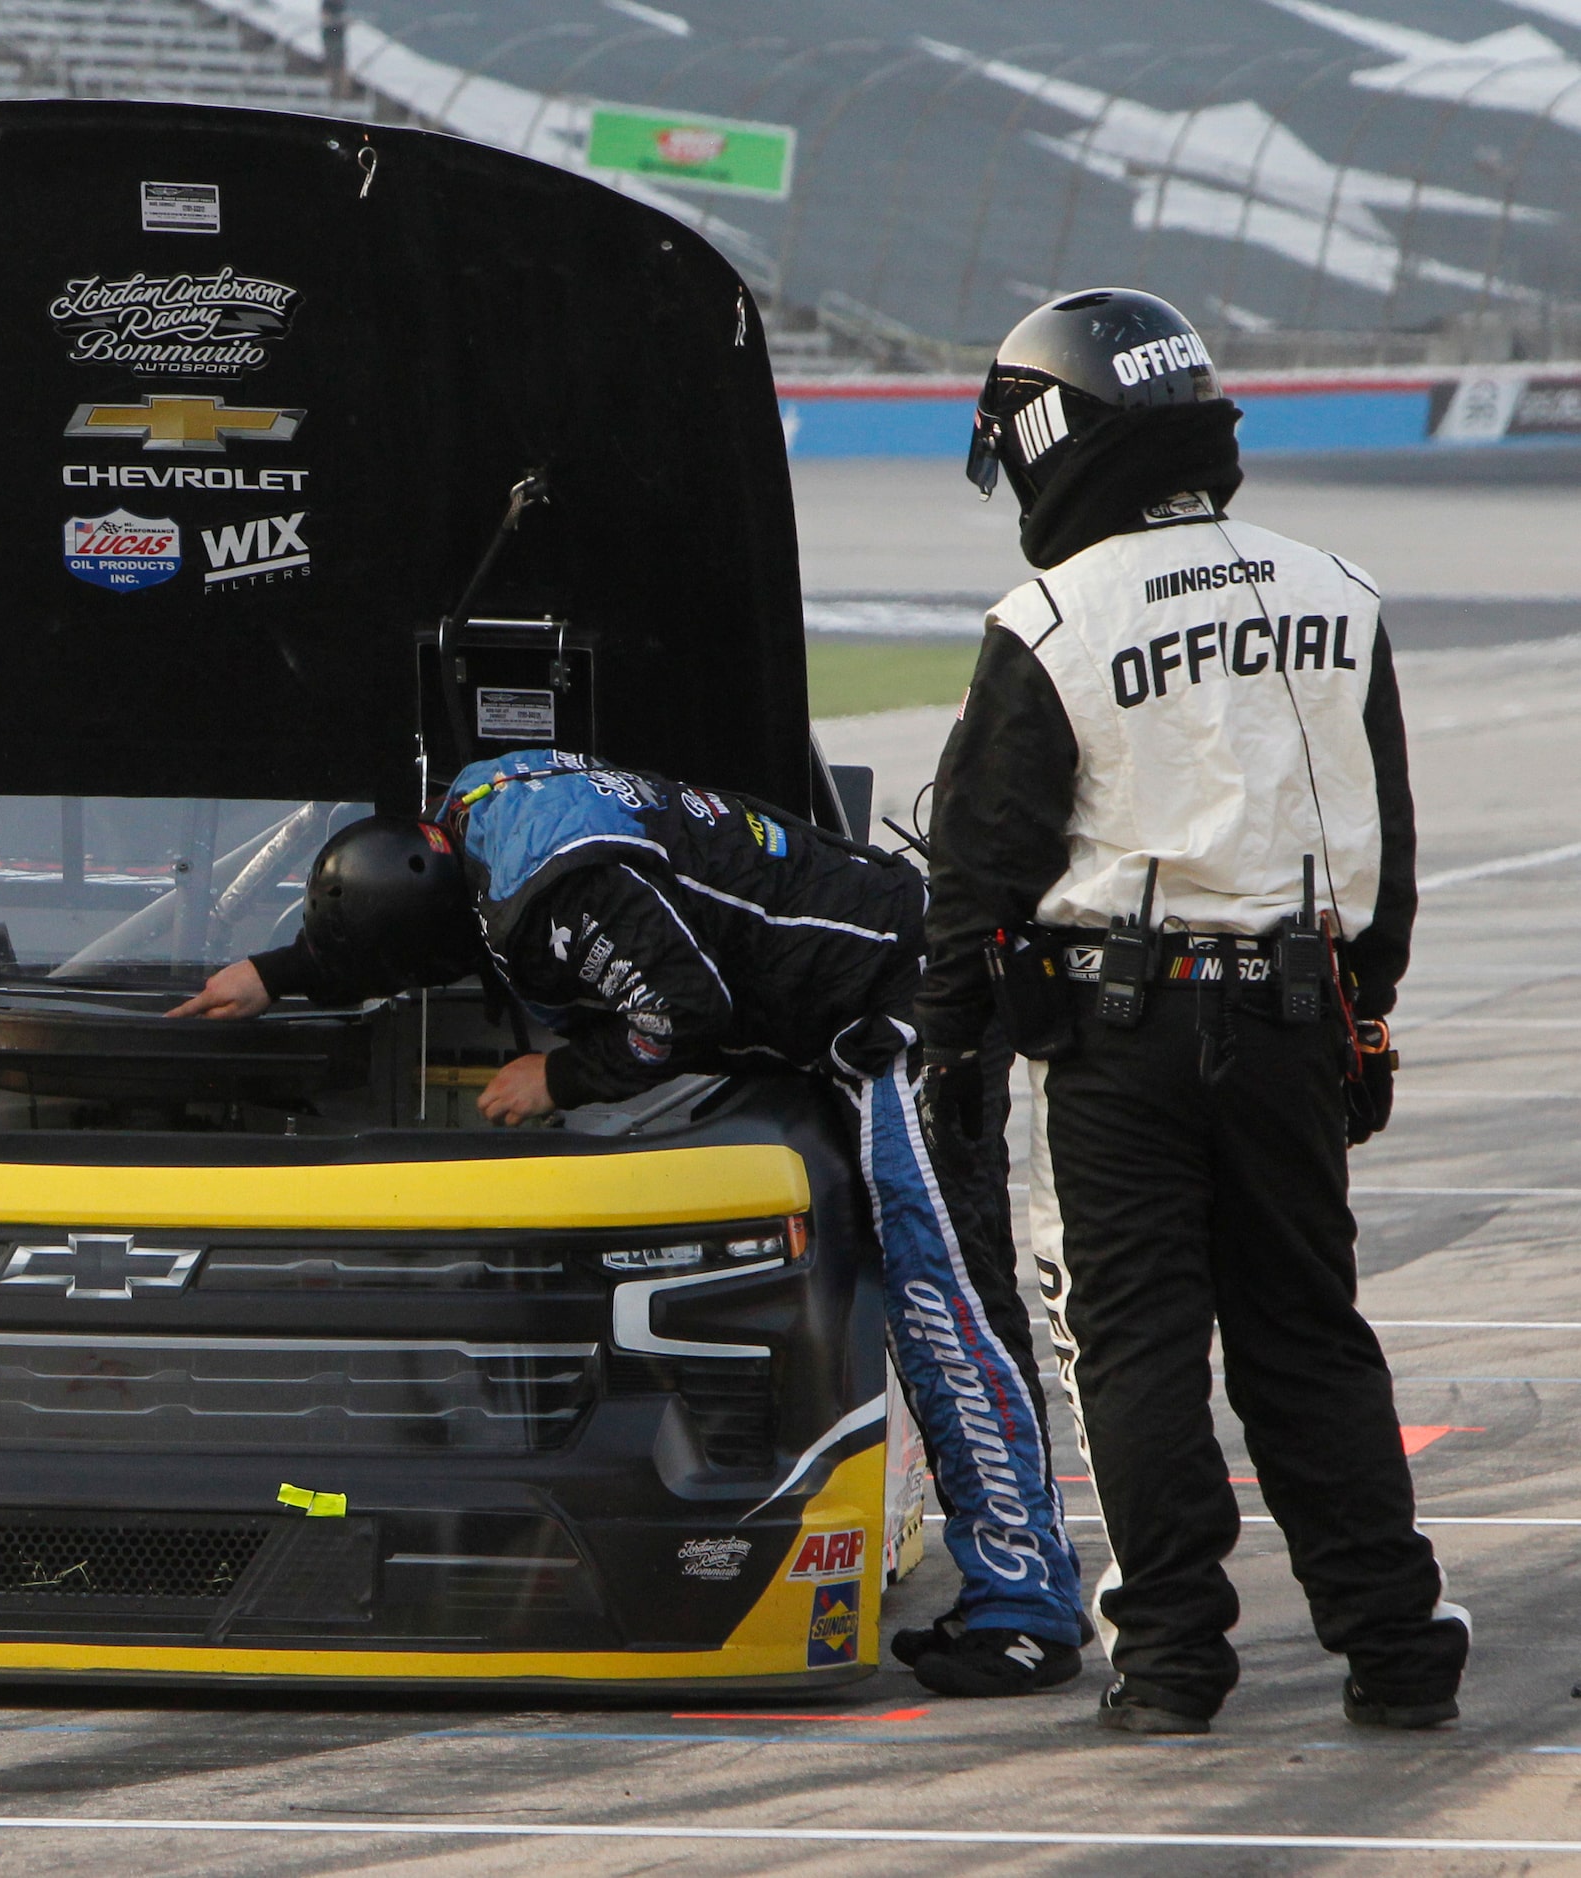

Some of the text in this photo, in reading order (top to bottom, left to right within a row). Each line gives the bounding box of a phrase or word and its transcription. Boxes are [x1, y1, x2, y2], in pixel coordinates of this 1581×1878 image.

[50, 266, 297, 319] Jordan Anderson
[118, 306, 224, 341] Racing
[70, 330, 265, 364] Bommarito
[1113, 333, 1214, 387] OFFICIA
[133, 362, 241, 374] AUTOSPORT
[62, 465, 310, 491] CHEVROLET
[75, 535, 173, 555] LUCAS
[201, 511, 310, 568] WIX
[71, 560, 175, 571] OIL PRODUCTS
[110, 574, 140, 584] INC.
[204, 566, 311, 595] FILTERS
[1180, 559, 1276, 594] NASCAR
[1111, 615, 1356, 709] OFFICIAL
[579, 933, 610, 982] KNIGHT
[904, 1279, 1049, 1591] Bommarito
[792, 1530, 865, 1573] ARP
[682, 1563, 741, 1577] Bommarito
[817, 1611, 859, 1638] SUNOCO
